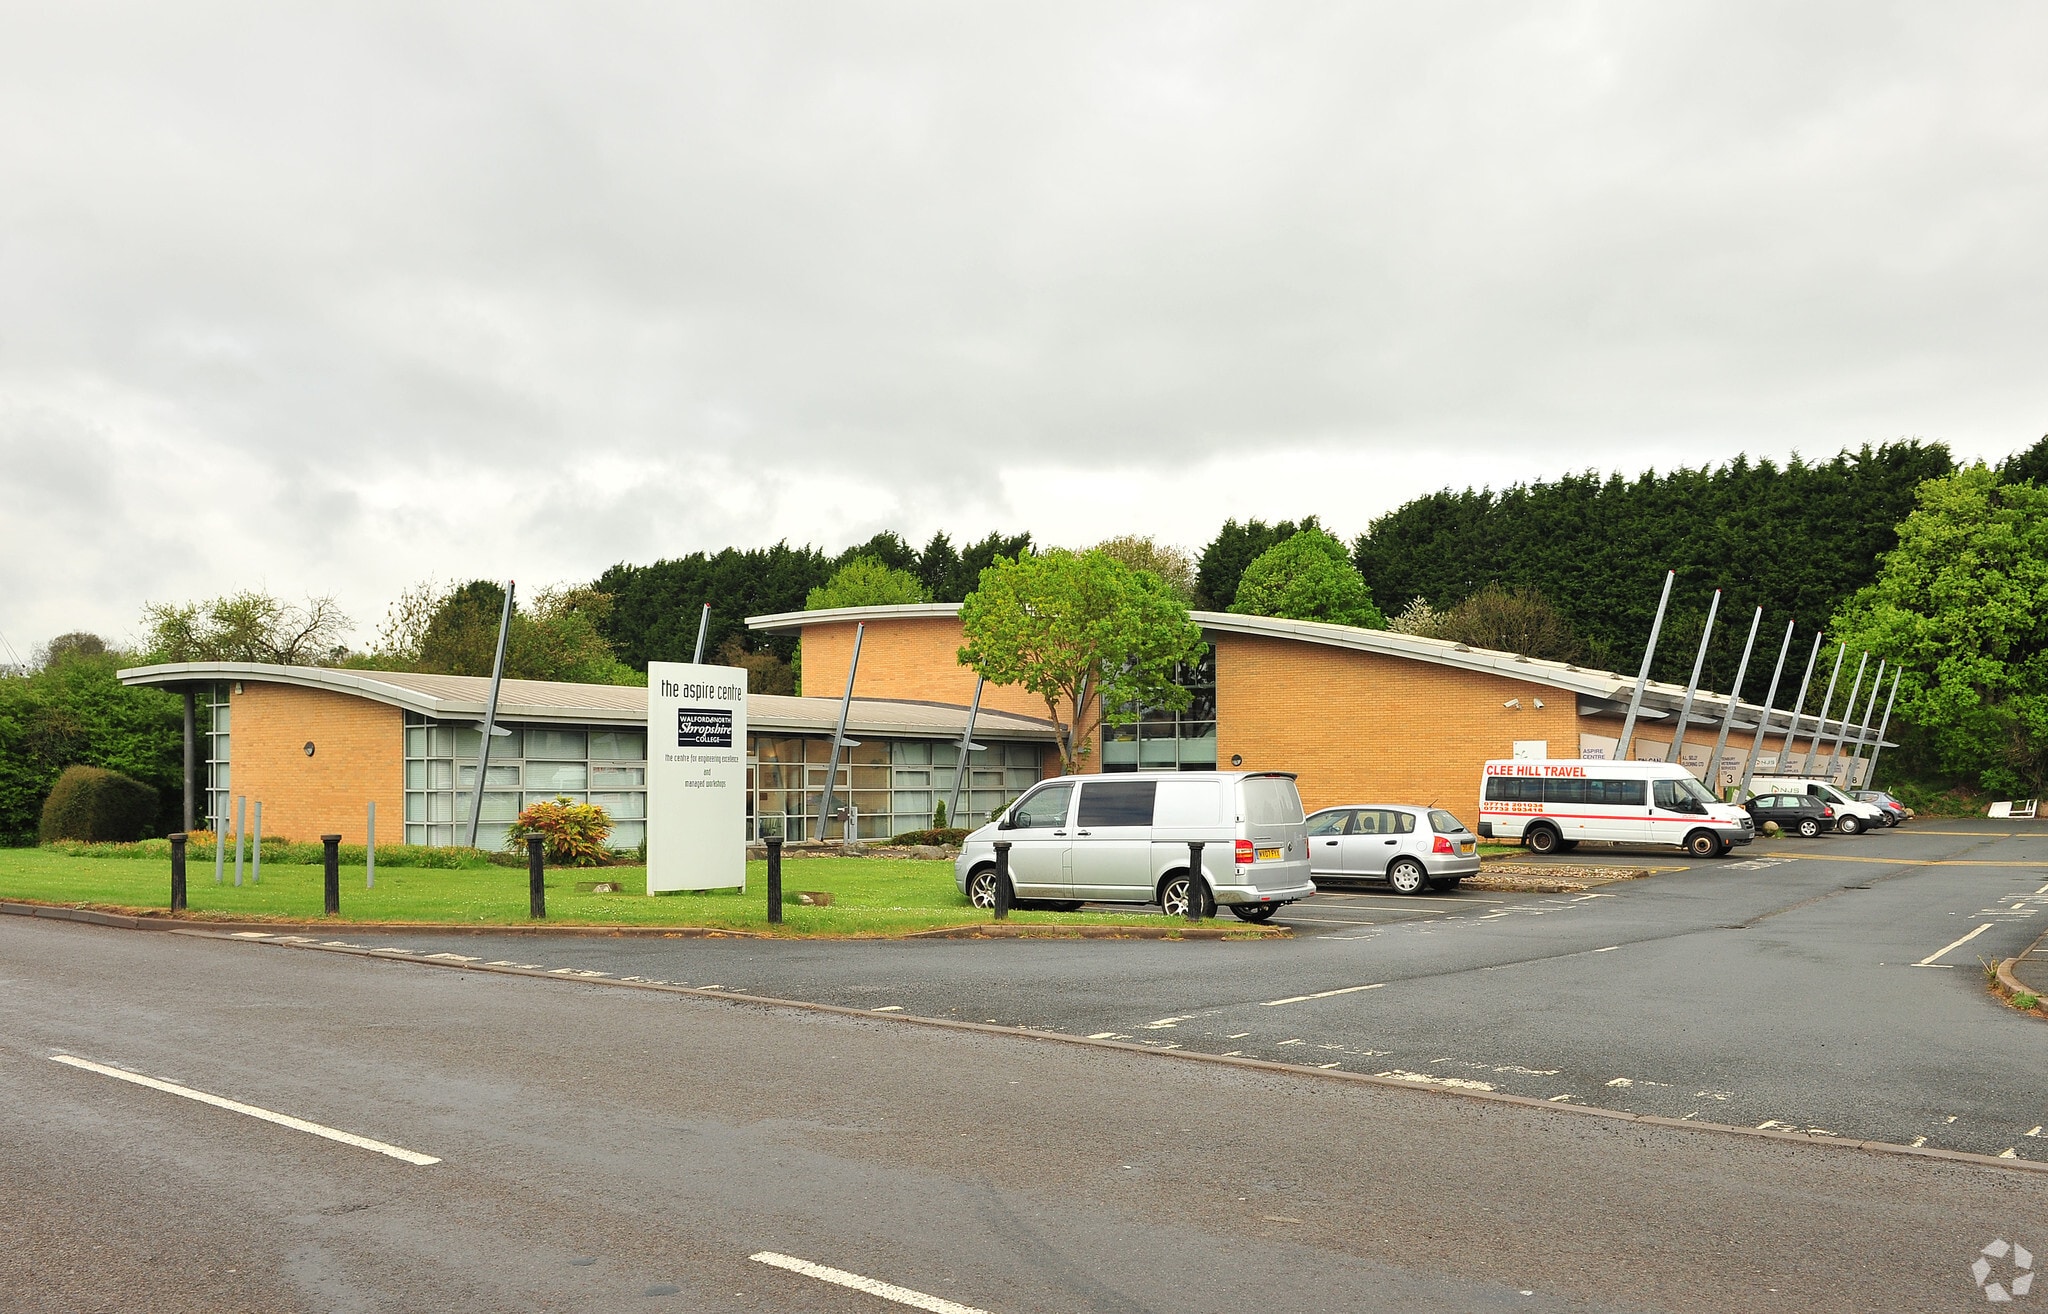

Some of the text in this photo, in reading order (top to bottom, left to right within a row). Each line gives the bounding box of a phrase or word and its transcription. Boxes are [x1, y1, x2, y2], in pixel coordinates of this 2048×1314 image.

[661, 679, 742, 702] the aspire centre
[679, 723, 732, 737] Shropshire
[664, 754, 673, 762] the
[674, 754, 690, 762] centre
[697, 755, 721, 764] engineering
[721, 755, 739, 763] excellence
[703, 768, 712, 776] and
[1486, 765, 1587, 777] CLEE HILL TRAVEL
[1726, 774, 1734, 784] 3
[1833, 776, 1838, 784] 7
[1852, 776, 1858, 784] 8
[684, 780, 727, 789] managed workshops
